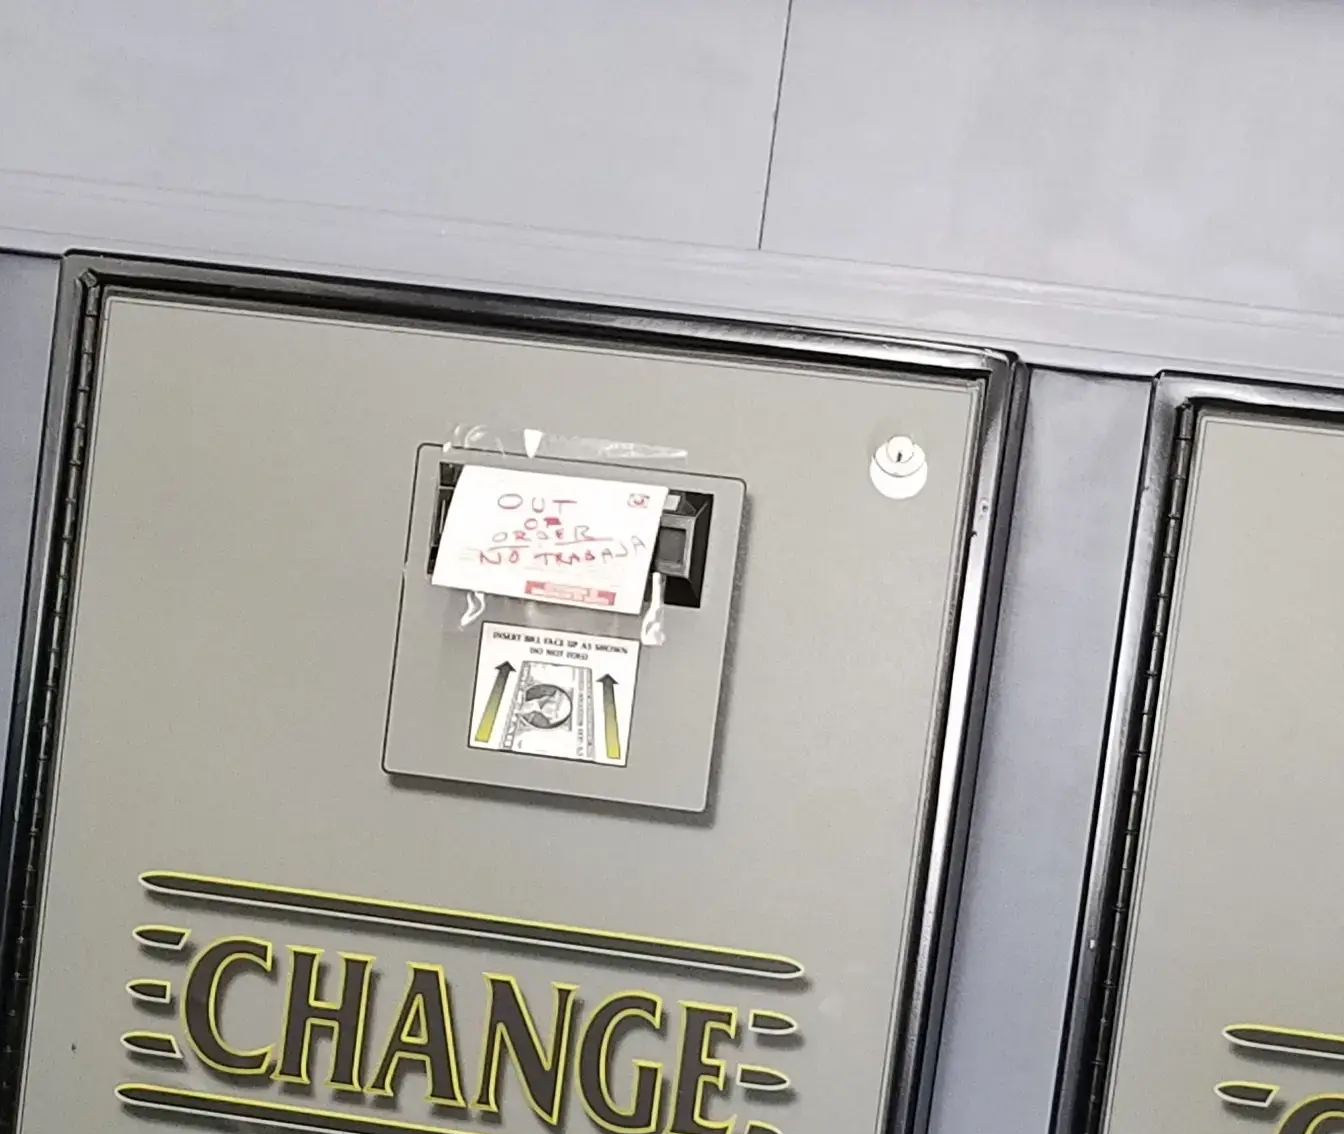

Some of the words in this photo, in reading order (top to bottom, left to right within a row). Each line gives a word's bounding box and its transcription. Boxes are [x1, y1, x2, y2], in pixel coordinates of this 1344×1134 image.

[497, 493, 578, 514] OUT
[492, 525, 596, 543] ORDER
[479, 550, 520, 565] NO
[533, 535, 646, 566] TRABAJA
[567, 639, 580, 649] UP
